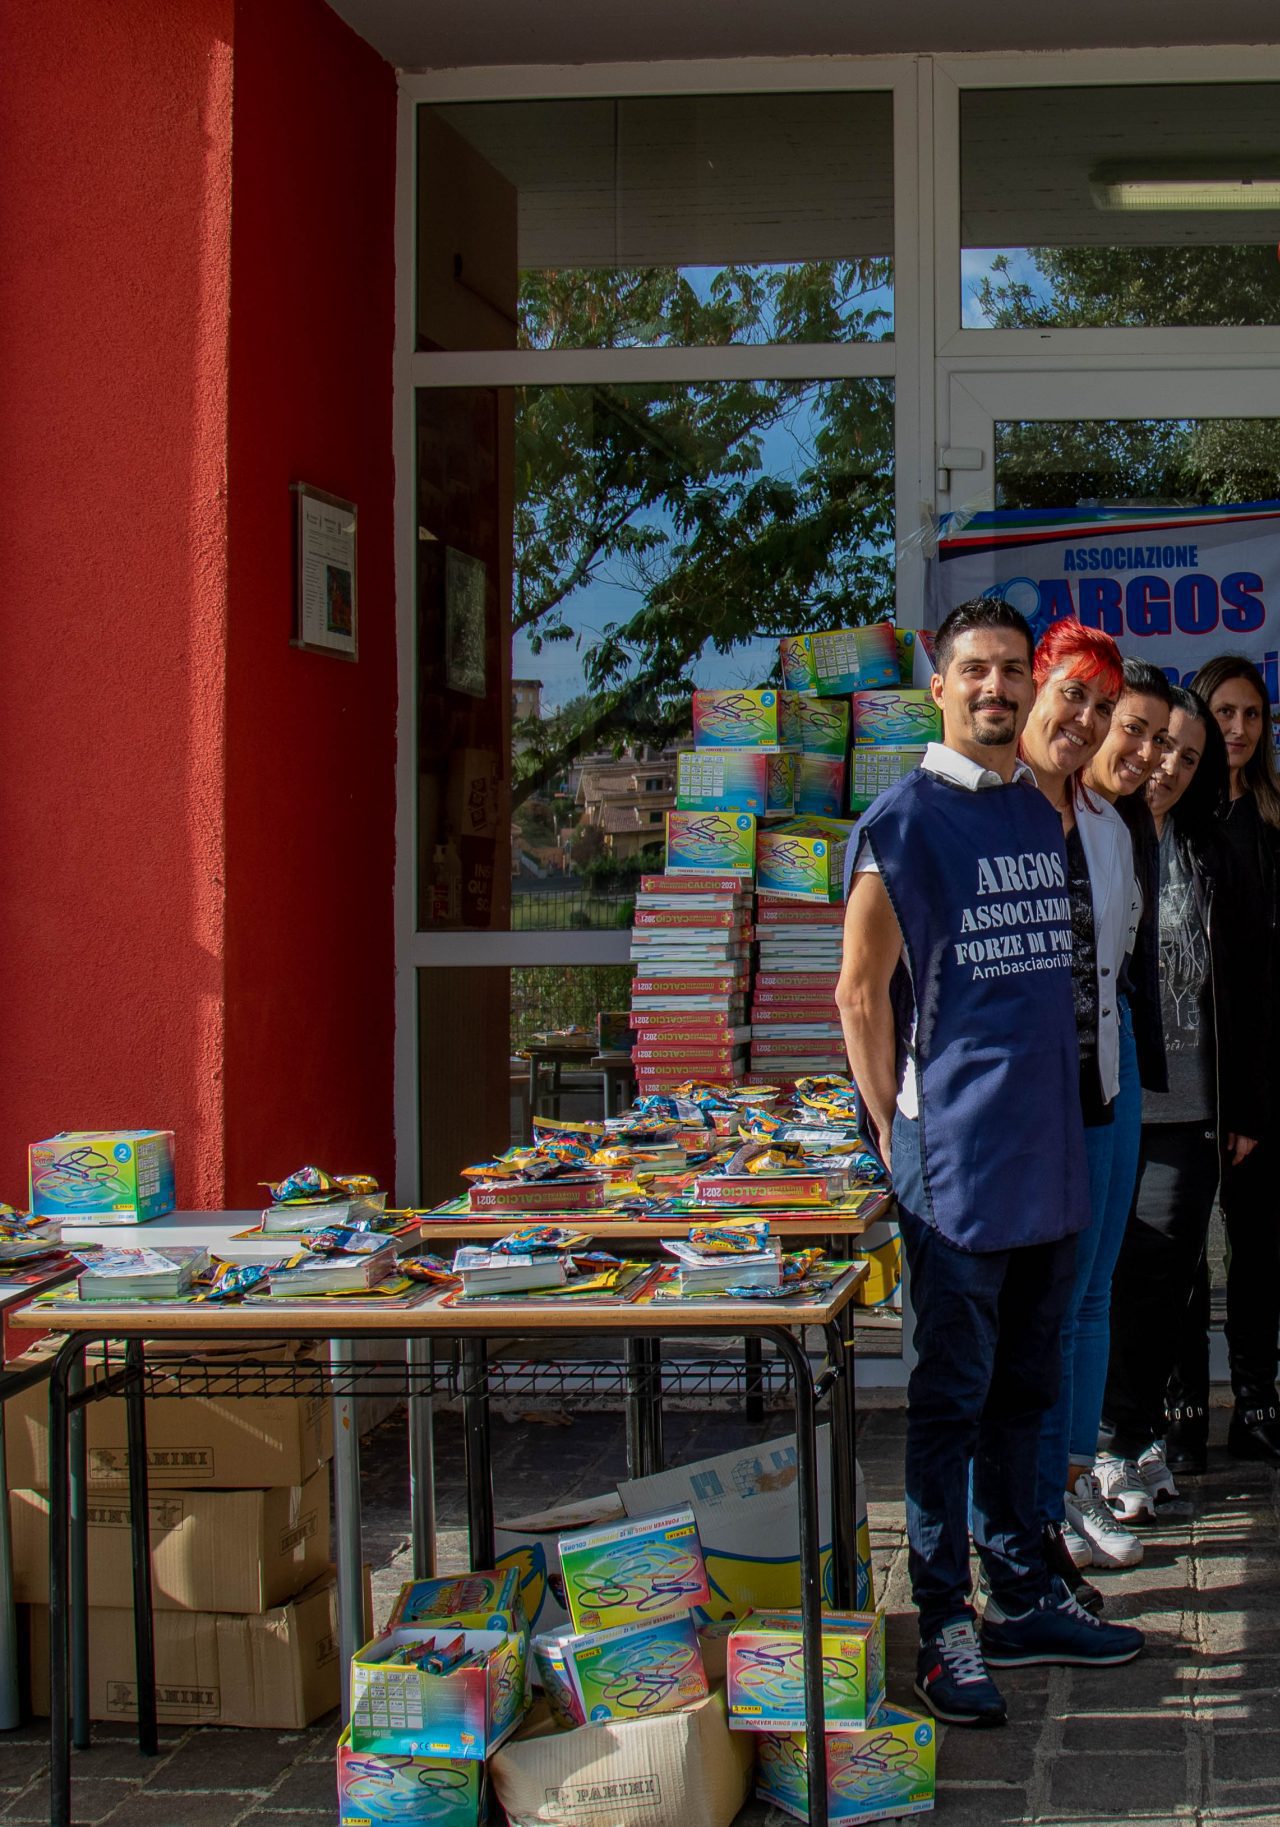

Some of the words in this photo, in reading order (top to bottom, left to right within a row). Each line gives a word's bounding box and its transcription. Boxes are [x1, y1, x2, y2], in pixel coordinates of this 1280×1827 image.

[1063, 544, 1199, 571] ASSOCIAZIONE
[1037, 571, 1266, 637] ARGOS
[764, 695, 772, 705] 2
[741, 818, 748, 827] 2
[816, 845, 823, 854] 2
[977, 851, 1065, 895] ARGOS
[687, 881, 720, 889] CALCIO
[721, 881, 736, 889] 2021
[960, 897, 1072, 933] ASSOCIAZION
[954, 934, 1025, 966] FORZE
[1026, 931, 1047, 954] DI
[1048, 929, 1072, 952] POLI
[972, 953, 1061, 981] Ambasciatori
[637, 983, 652, 991] 2021
[634, 1016, 649, 1024] 2021
[643, 1032, 657, 1041] 2021
[657, 1032, 690, 1040] CALCIO
[637, 1050, 652, 1058] 2021
[652, 1050, 686, 1058] CALCIO
[640, 1066, 656, 1075] 2021
[656, 1066, 689, 1074] CALCIO
[118, 1148, 127, 1159] 2
[702, 1187, 721, 1197] 2021
[721, 1186, 767, 1198] CALCIO
[476, 1194, 497, 1206] 2021
[496, 1193, 543, 1206] CALCIO
[124, 1452, 207, 1466] NINI
[634, 1524, 653, 1534] RINGS
[653, 1518, 680, 1530] FOREVER
[667, 1529, 687, 1539] PANINI
[564, 1541, 587, 1552] COLORS
[155, 1690, 214, 1704] ANINI
[919, 1729, 928, 1742] 2
[577, 1780, 654, 1802] PANINI
